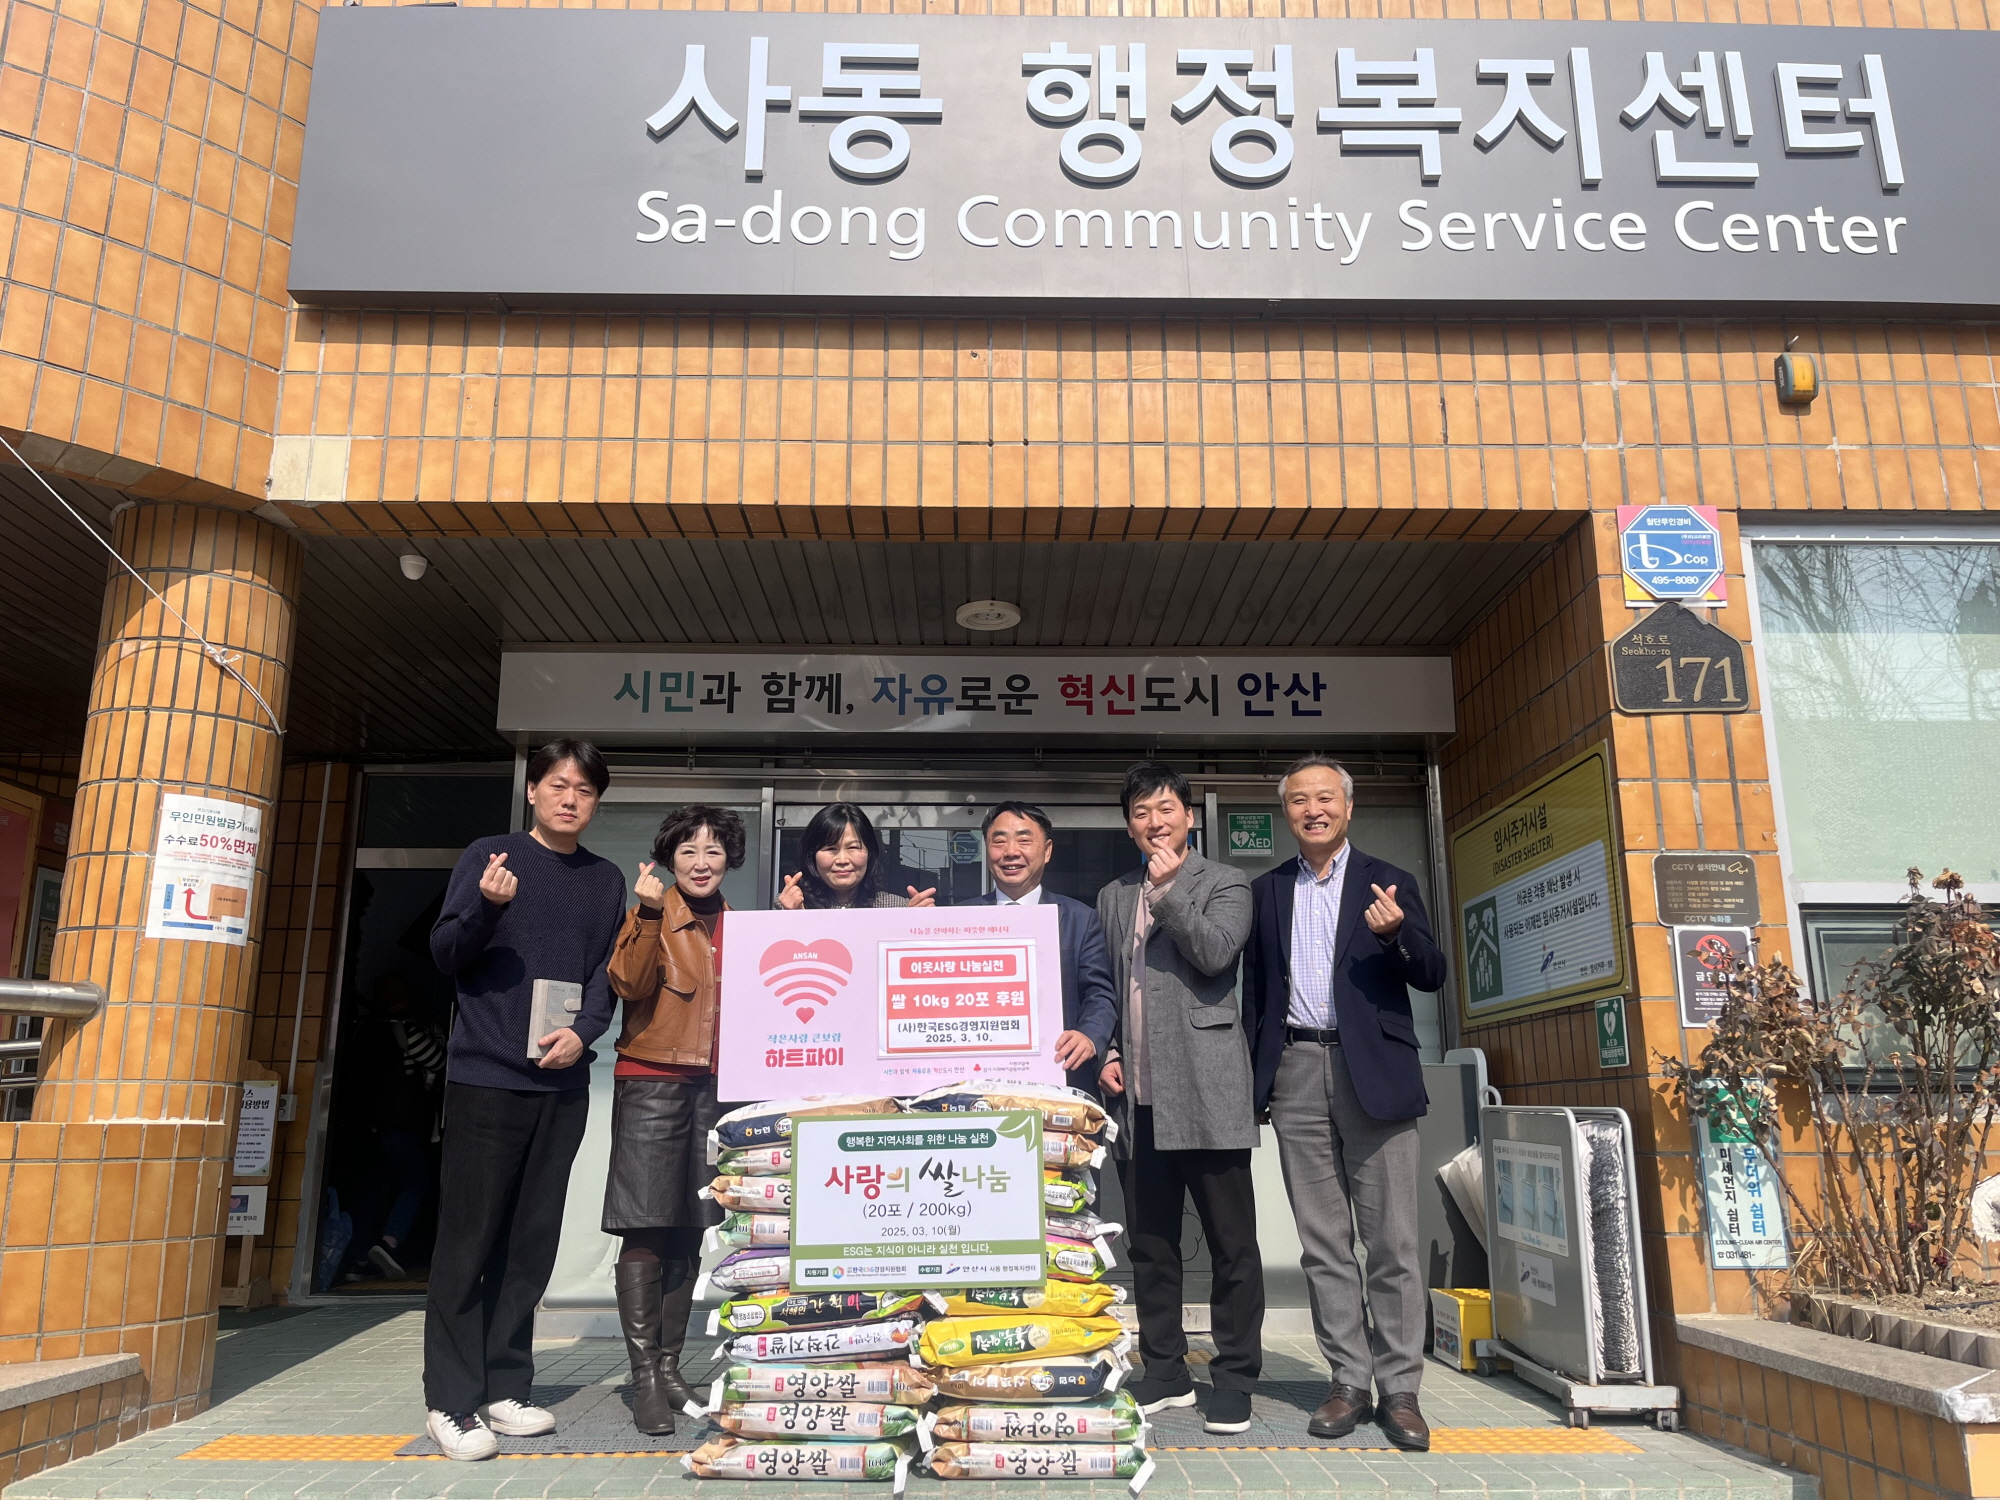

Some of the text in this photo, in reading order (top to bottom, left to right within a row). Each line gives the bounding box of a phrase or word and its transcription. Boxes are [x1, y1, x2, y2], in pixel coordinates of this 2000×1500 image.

[645, 36, 1905, 191] 사동 행정복지센터
[636, 189, 1908, 266] Sa-dong Community Service Center
[1683, 554, 1709, 566] Cop
[1651, 576, 1699, 585] 495-8080
[1631, 634, 1671, 646] 석호로
[1621, 647, 1671, 656] Seokho-ro
[1655, 656, 1741, 703] 171
[612, 670, 1327, 718] 시민과 함께, 자유로운 혁신도시 안산
[1493, 801, 1548, 854] 임시주거시설
[163, 834, 198, 846] 수수료
[1247, 838, 1271, 848] AED
[1671, 863, 1694, 871] CCTV
[1683, 915, 1707, 923] CCTV
[792, 952, 818, 960] ANSAN
[910, 959, 1004, 974] 이웃사랑 나눔실천
[891, 990, 1025, 1010] 쌀 10kg 20포 후원
[897, 1018, 1020, 1034] (사)한국ESG경영지원협회
[767, 1033, 809, 1044] 작은사랑
[925, 1032, 993, 1044] 2025. 3. 10.
[765, 1047, 844, 1068] 하트파이
[754, 1125, 771, 1135] 농협
[845, 1131, 989, 1148] 행복한 지역사회를 위한 나눔 실천
[824, 1163, 910, 1200] 사랑의
[1719, 1147, 1741, 1236] 미세먼지 쉼터
[1743, 1148, 1767, 1237] 무더위 쉼터
[862, 1200, 973, 1220] (20포 / 200kg)
[881, 1224, 961, 1237] 2025. 03. 10(월)
[843, 1242, 993, 1257] ESG는 지식이 아니라 실천 입니다.
[769, 1333, 840, 1356] 간척지쌀
[786, 1372, 861, 1399] 영양쌀
[1058, 1376, 1077, 1385] 농협
[779, 1402, 851, 1432] 영양쌀
[1000, 1411, 1075, 1439] 영양쌀
[758, 1447, 832, 1476] 영양쌀
[1007, 1449, 1082, 1476] 영양쌀
